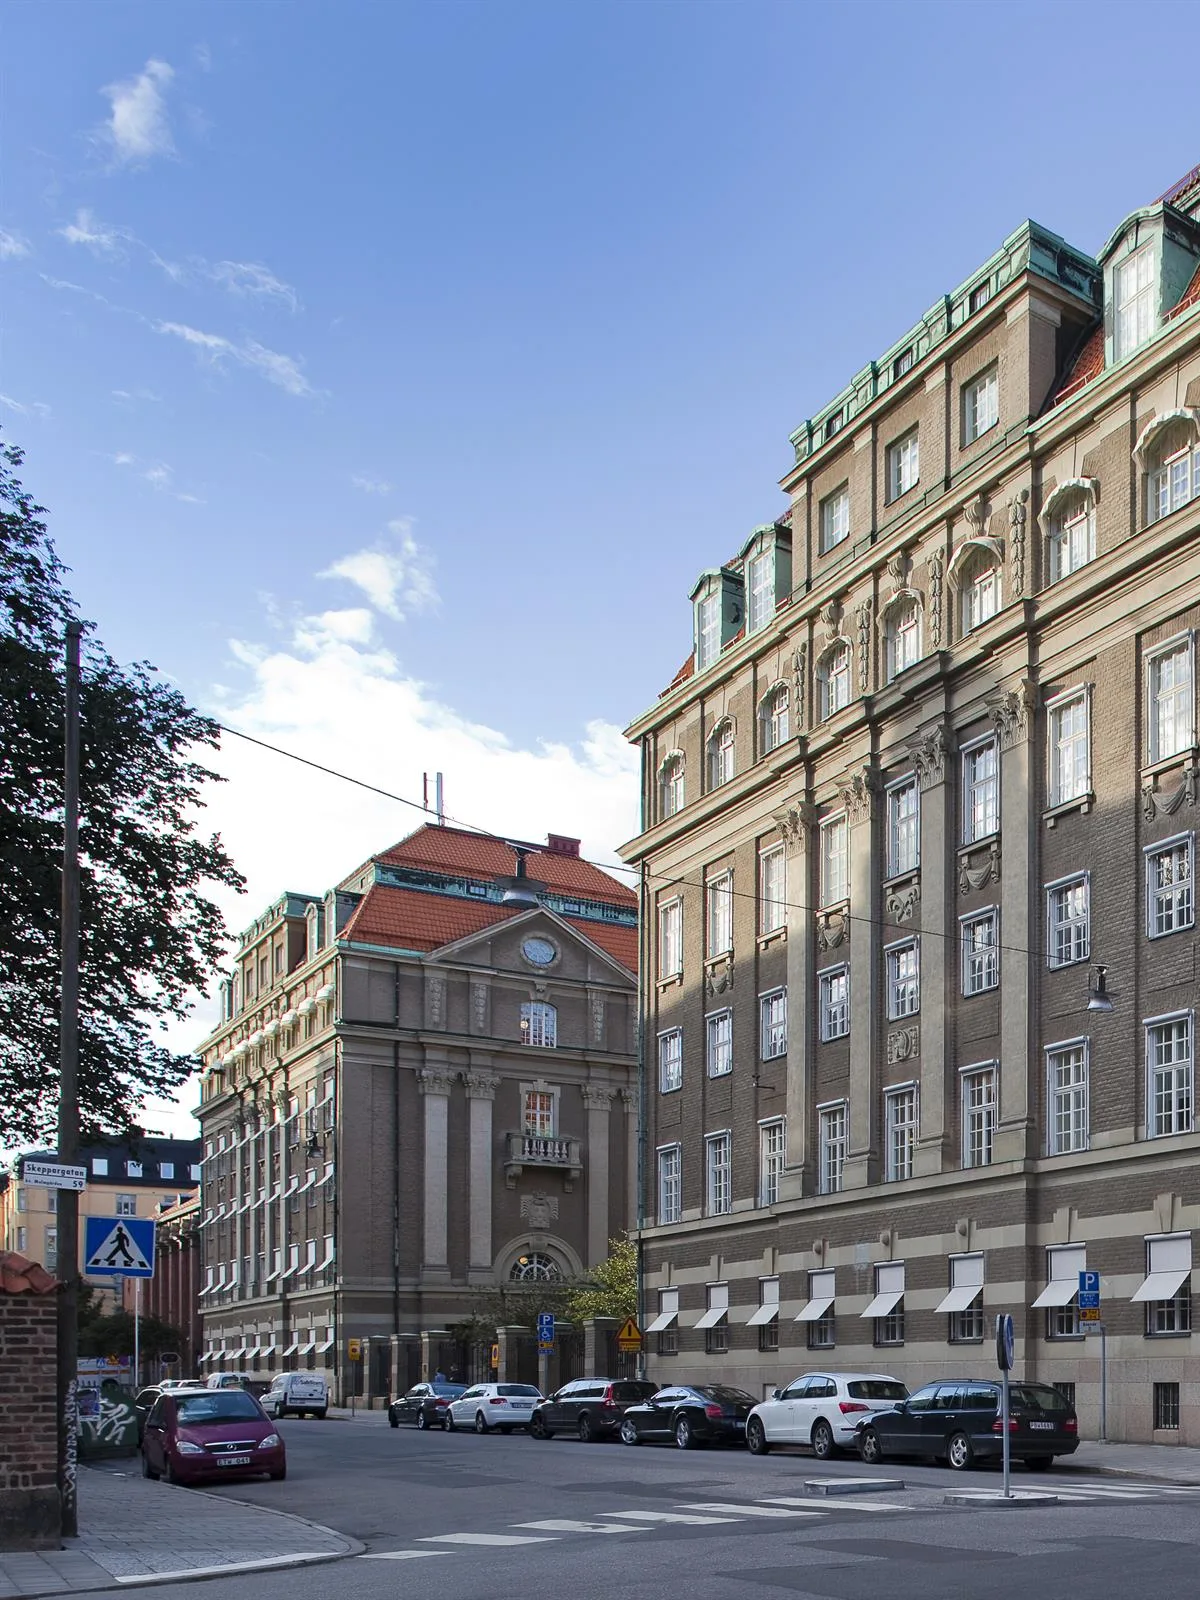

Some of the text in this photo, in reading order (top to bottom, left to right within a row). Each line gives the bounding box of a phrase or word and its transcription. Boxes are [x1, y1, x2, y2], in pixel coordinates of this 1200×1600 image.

[27, 1164, 84, 1177] Skeppargatan
[73, 1180, 84, 1188] 59
[1085, 1273, 1095, 1290] P
[543, 1315, 551, 1325] P
